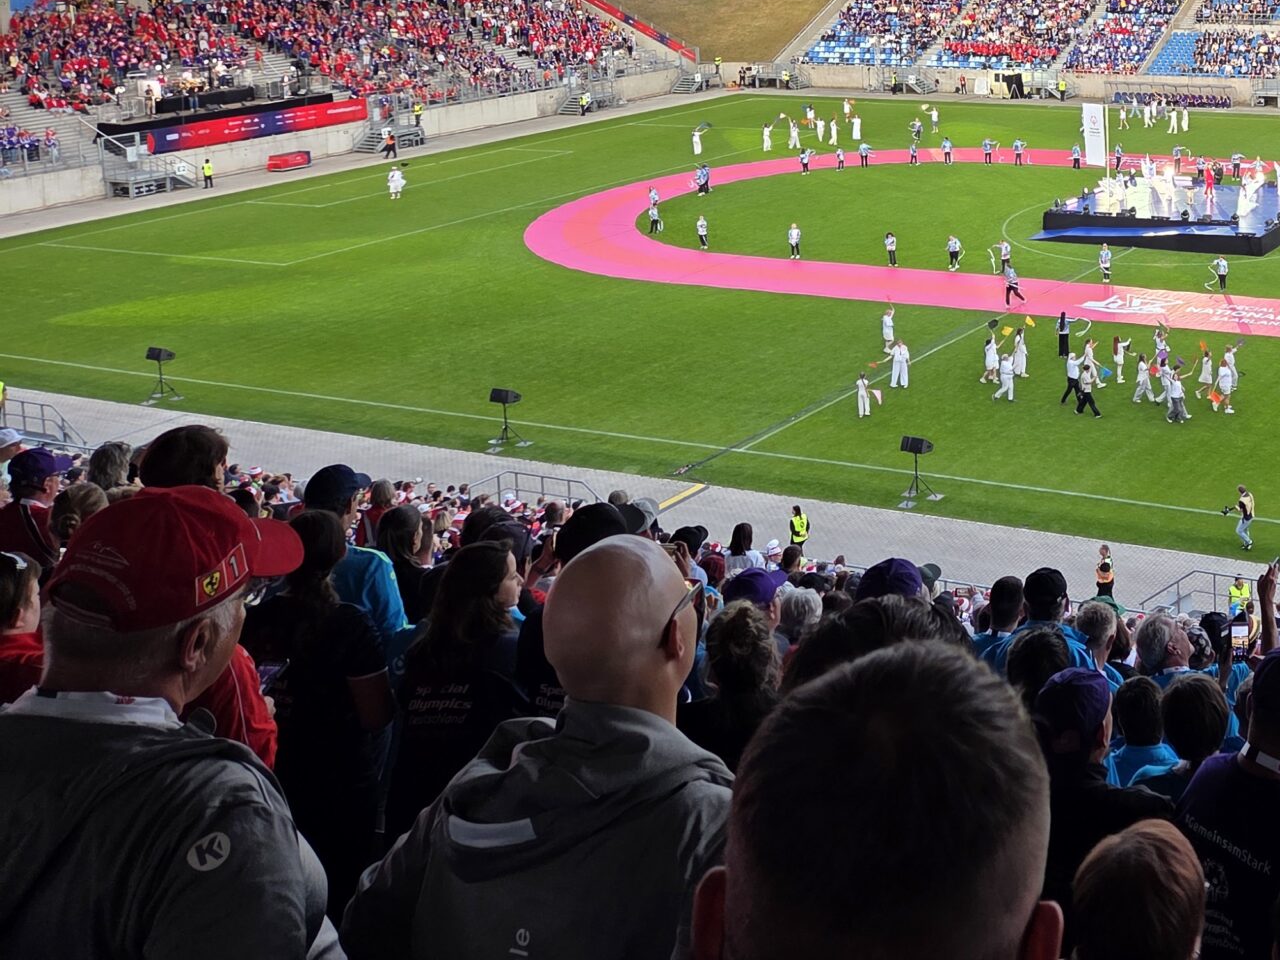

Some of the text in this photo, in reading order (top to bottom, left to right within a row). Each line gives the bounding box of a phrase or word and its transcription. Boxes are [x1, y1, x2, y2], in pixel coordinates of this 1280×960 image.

[1221, 303, 1274, 313] SPECIAL
[229, 555, 240, 579] 1
[416, 683, 470, 696] Spcial
[408, 698, 472, 712] Olympics
